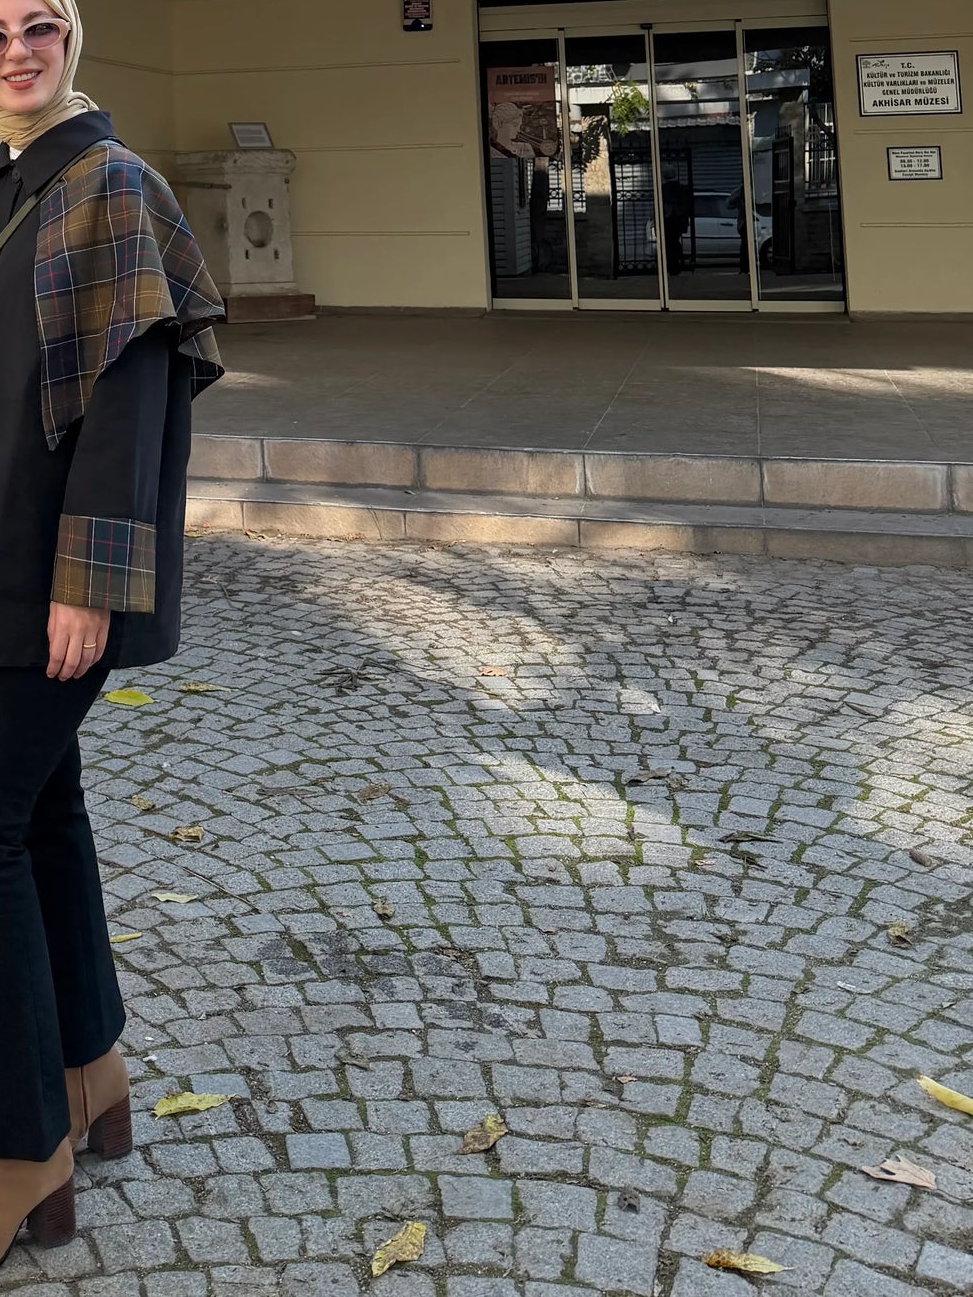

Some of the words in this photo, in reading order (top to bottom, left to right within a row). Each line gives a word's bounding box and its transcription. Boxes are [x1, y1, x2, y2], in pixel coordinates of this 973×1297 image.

[867, 71, 888, 79] KÜLTÜR
[897, 70, 919, 78] TURİZM
[920, 69, 951, 77] BAKANLIĞI
[863, 80, 885, 88] KÜLTÜR
[901, 86, 938, 95] MÜDÜRLÜĞÜ
[872, 98, 911, 107] AKHİSAR
[914, 96, 949, 106] MÜZESİ
